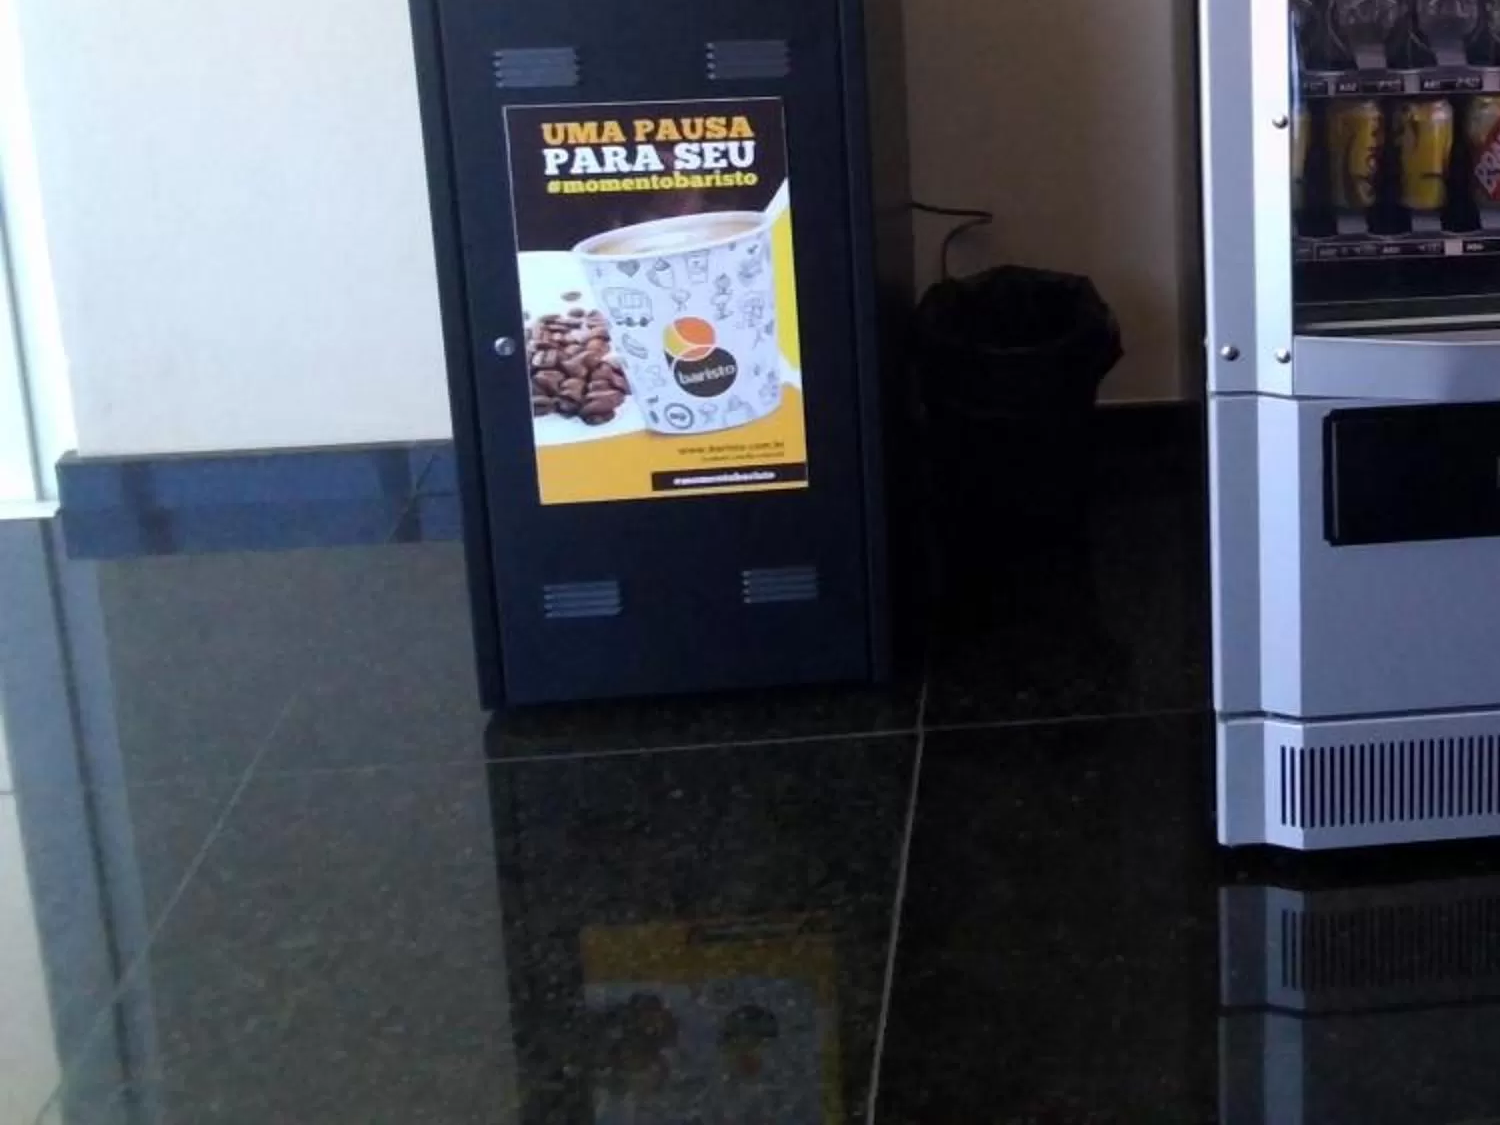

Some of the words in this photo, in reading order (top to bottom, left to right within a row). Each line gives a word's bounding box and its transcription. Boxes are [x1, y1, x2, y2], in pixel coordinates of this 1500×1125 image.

[541, 120, 627, 146] UMA
[633, 115, 755, 143] PAUSA
[542, 143, 665, 175] PARA
[673, 140, 756, 171] SEU
[546, 170, 759, 194] #momentobaristo
